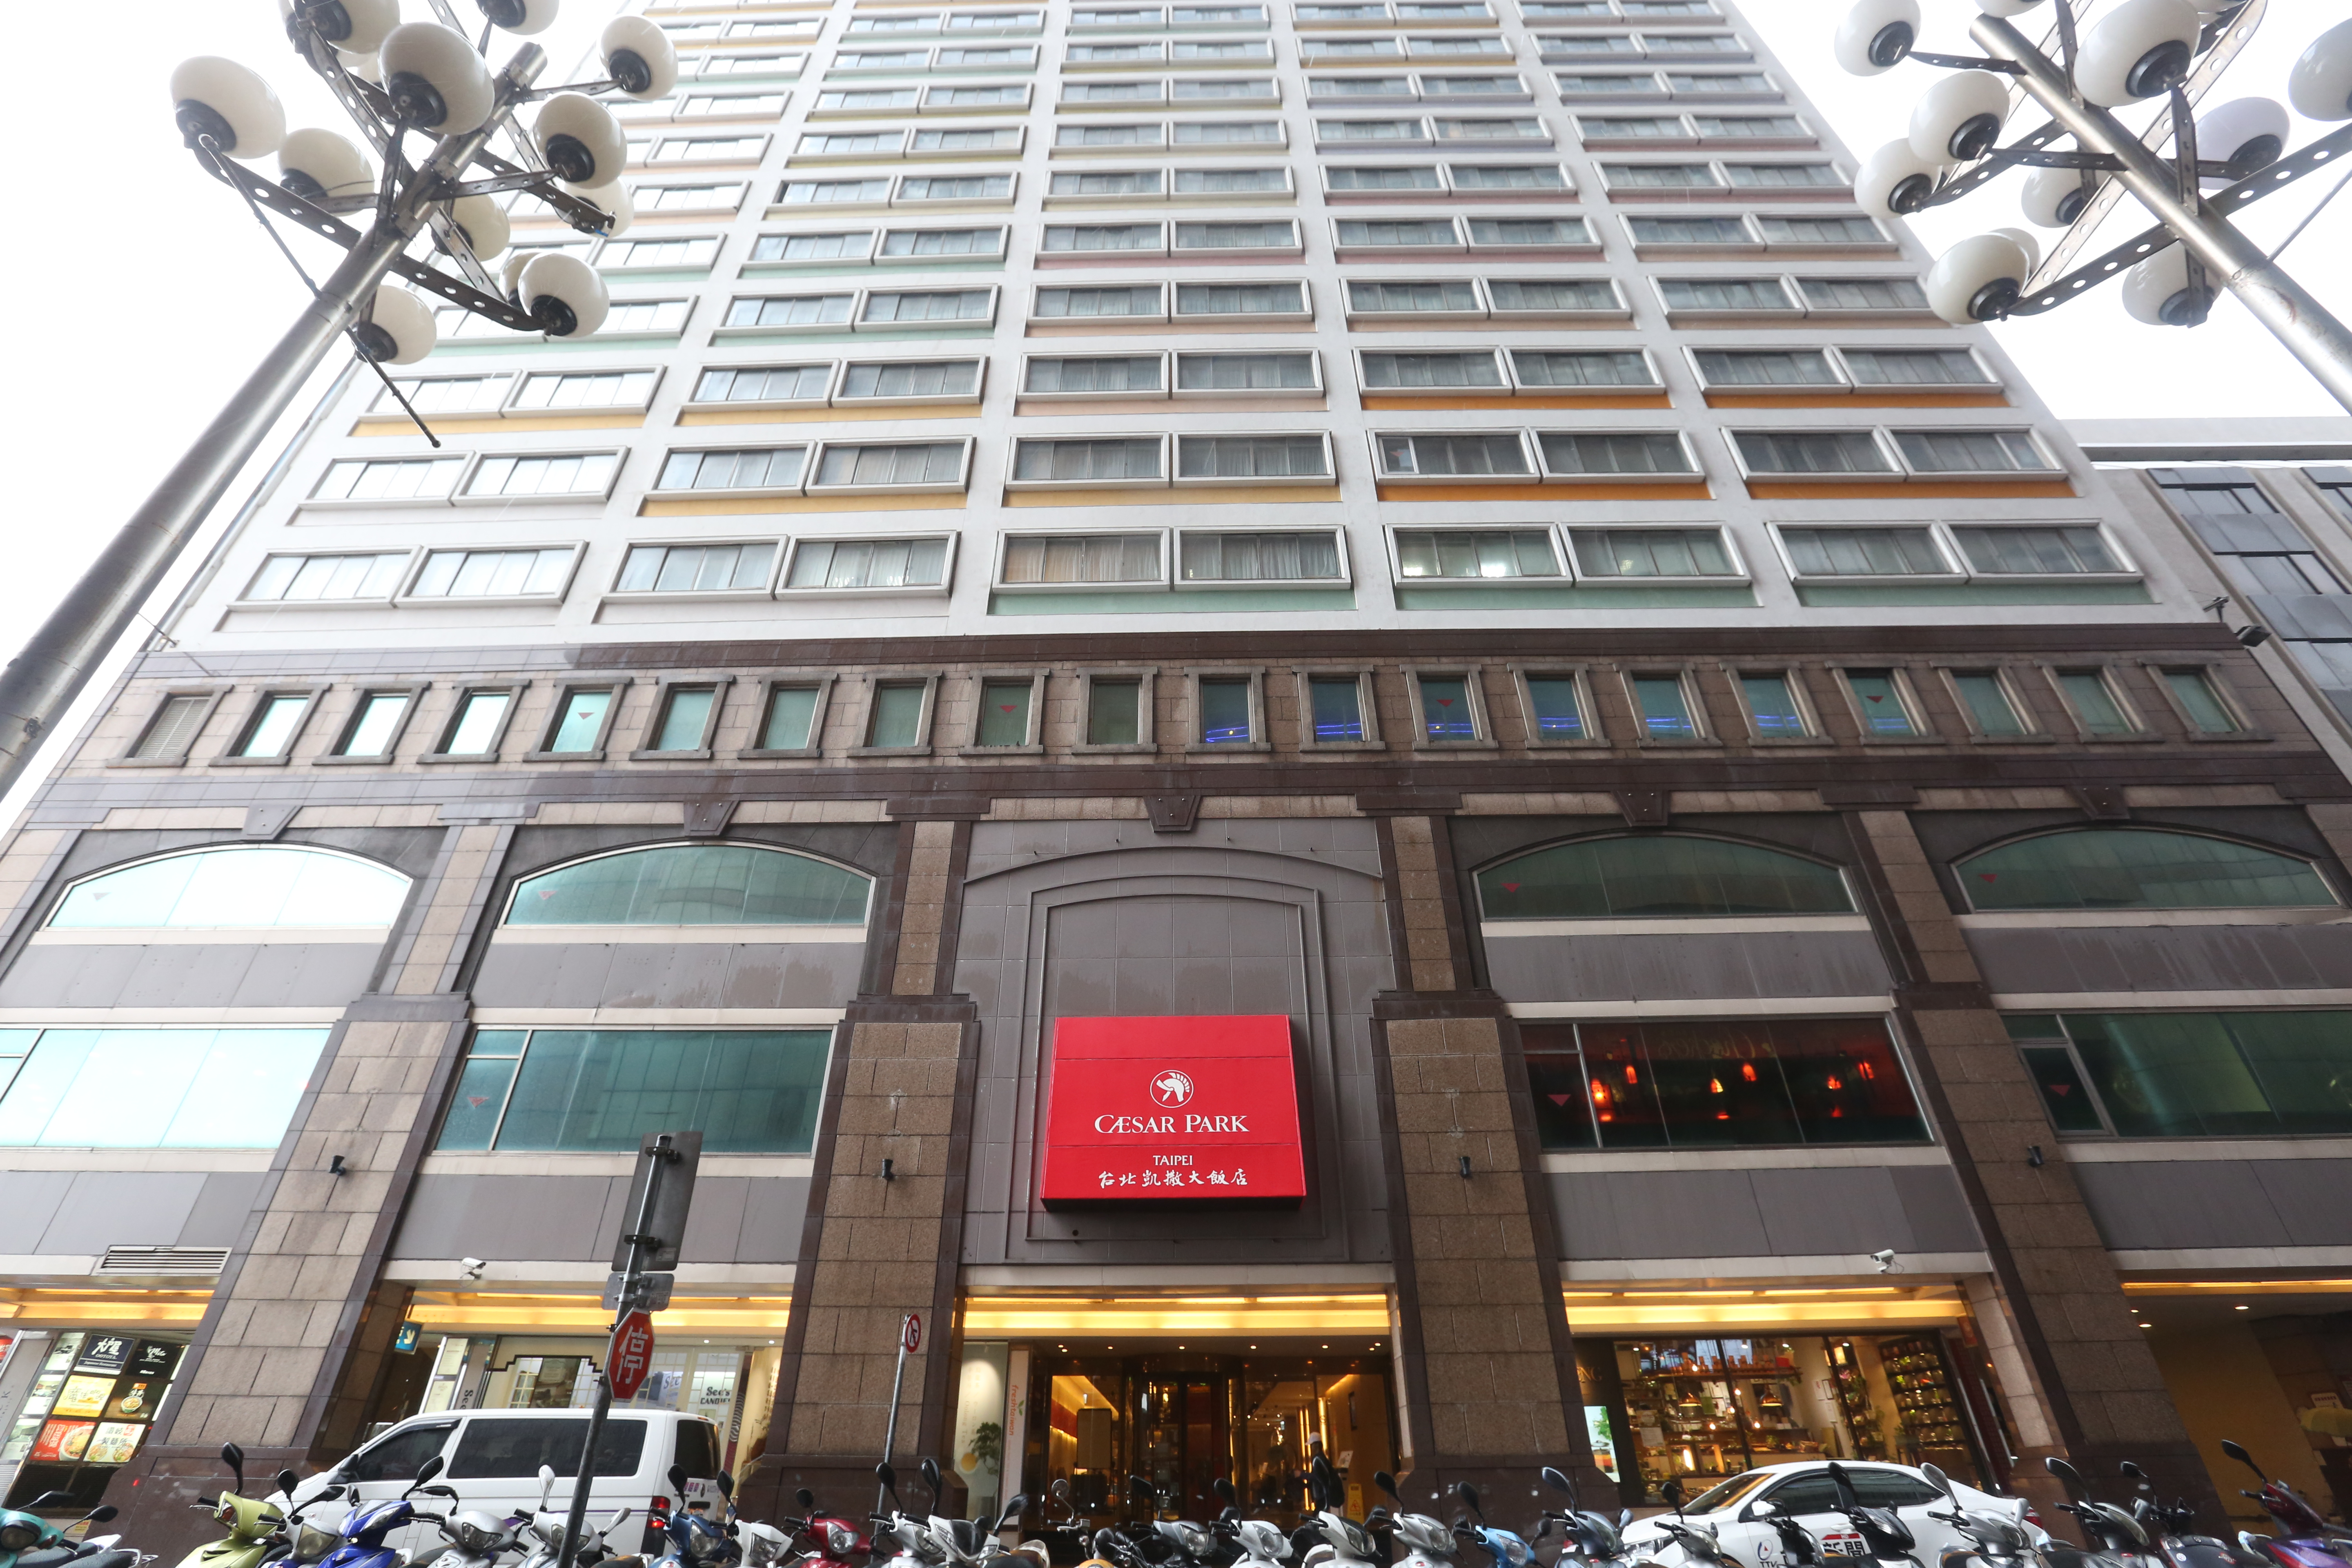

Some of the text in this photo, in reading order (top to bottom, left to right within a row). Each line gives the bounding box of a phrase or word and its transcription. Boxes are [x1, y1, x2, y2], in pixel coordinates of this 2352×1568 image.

[1184, 1114, 1250, 1132] PARK
[1153, 1155, 1193, 1166] TAIPEI
[1098, 1168, 1248, 1189] 台北凱撒大飯店
[616, 1325, 649, 1384] 停
[1009, 1385, 1019, 1436] freshtaiwan
